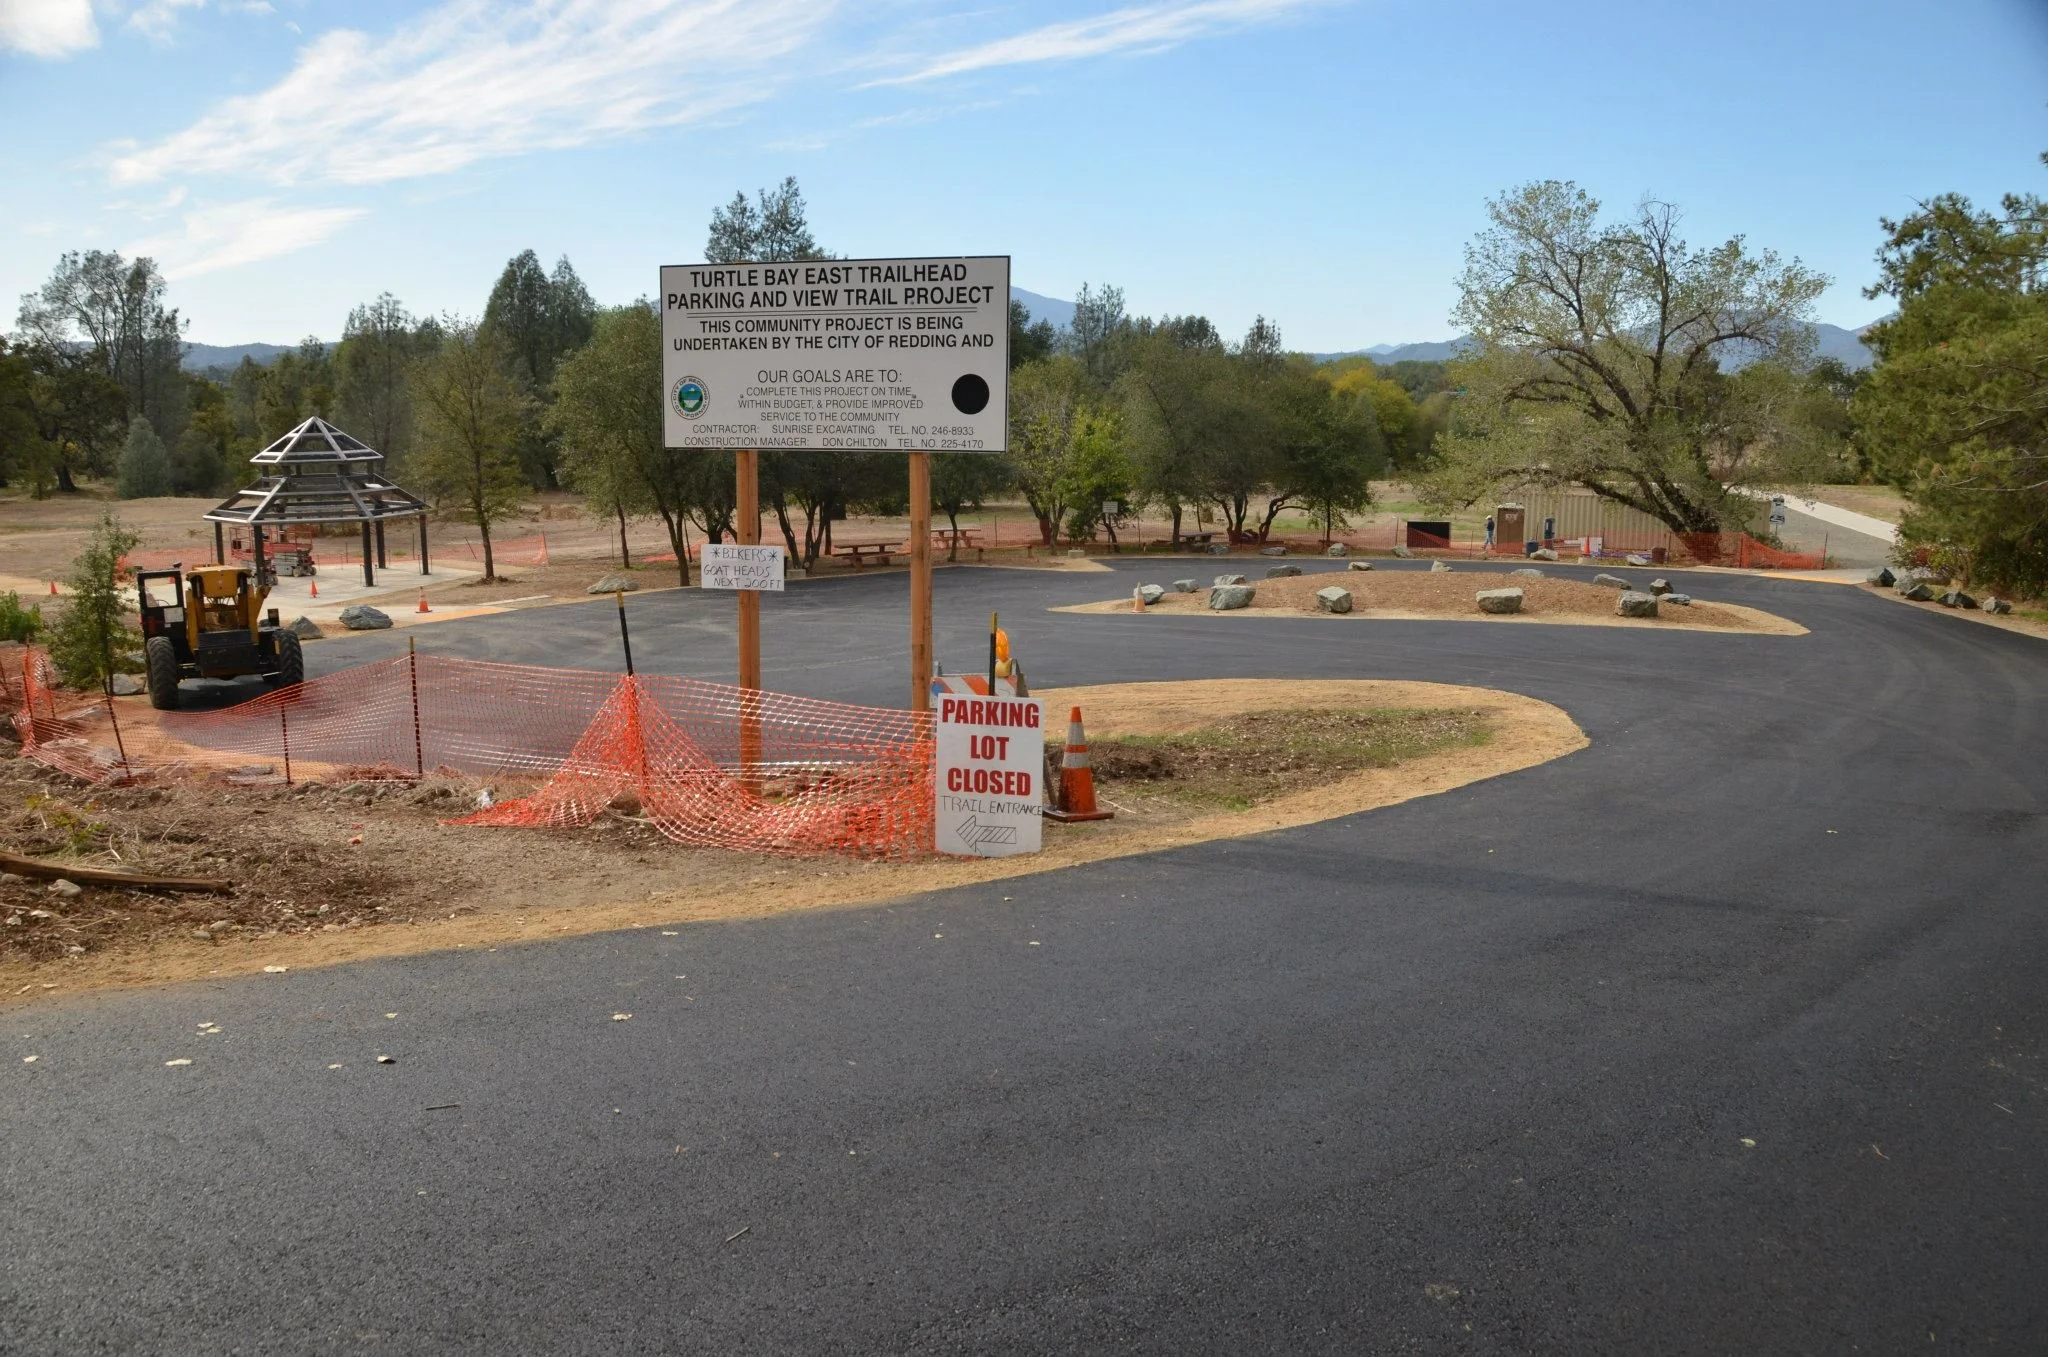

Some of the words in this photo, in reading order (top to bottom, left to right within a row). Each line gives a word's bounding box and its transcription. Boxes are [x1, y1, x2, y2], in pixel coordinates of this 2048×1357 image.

[690, 270, 758, 287] TURTLE
[764, 269, 799, 286] BAY
[805, 267, 852, 285] EAST
[858, 264, 967, 283] TRAILHEAD
[668, 292, 745, 310] PARKING
[750, 290, 787, 308] AND
[793, 289, 838, 307] VIEW
[844, 288, 898, 306] TRAIL
[904, 286, 994, 304] PROJECT
[700, 320, 731, 333] THIS
[735, 318, 820, 333] COMMUNITY
[826, 317, 893, 331] PROJECT
[898, 316, 911, 330] IS
[916, 316, 963, 330] BEING
[674, 337, 767, 351] UNDERTAKEN
[772, 336, 790, 349] BY
[795, 336, 823, 349] THE
[827, 335, 859, 349] CITY
[864, 335, 884, 348] OF
[889, 334, 957, 348] REDDING
[961, 334, 994, 347] AND
[757, 370, 788, 383] OUR
[793, 369, 841, 383] GOALS
[845, 369, 874, 382] ARE
[878, 369, 902, 382] TO:
[747, 387, 801, 396] COMPLETE
[803, 387, 821, 396] THIS
[824, 387, 868, 396] PROJECT
[871, 387, 886, 396] ON
[738, 400, 771, 409] WITHIN
[816, 400, 823, 409] &
[826, 400, 868, 409] PROVIDE
[871, 400, 924, 409] IMPROVED
[761, 412, 801, 421] SERVICE
[804, 412, 816, 421] TO
[819, 412, 837, 421] THE
[840, 412, 900, 421] COMMUNITY
[692, 424, 760, 434] CONTRACTOR:
[772, 424, 813, 434] SUNRISE
[816, 425, 875, 434] EXCAVATING
[889, 426, 909, 435] TEL.
[911, 426, 929, 435] NO.
[931, 426, 974, 436] 246-8933
[684, 437, 757, 446] CONSTRUCTION
[760, 437, 809, 447] MANAGER:
[822, 438, 844, 447] DON
[846, 437, 887, 447] CHILTON
[898, 439, 918, 448] TEL.
[921, 439, 938, 448] NO.
[941, 439, 984, 449] 225-4170
[703, 564, 730, 576] GOAT
[734, 565, 771, 578] HEADS
[713, 578, 740, 587] NEXT
[942, 698, 1039, 728] PARKING
[970, 735, 1010, 760] LOT
[947, 767, 1031, 796] CLOSED
[940, 795, 988, 813] TRAIL
[989, 800, 1043, 816] ENTRANCE
